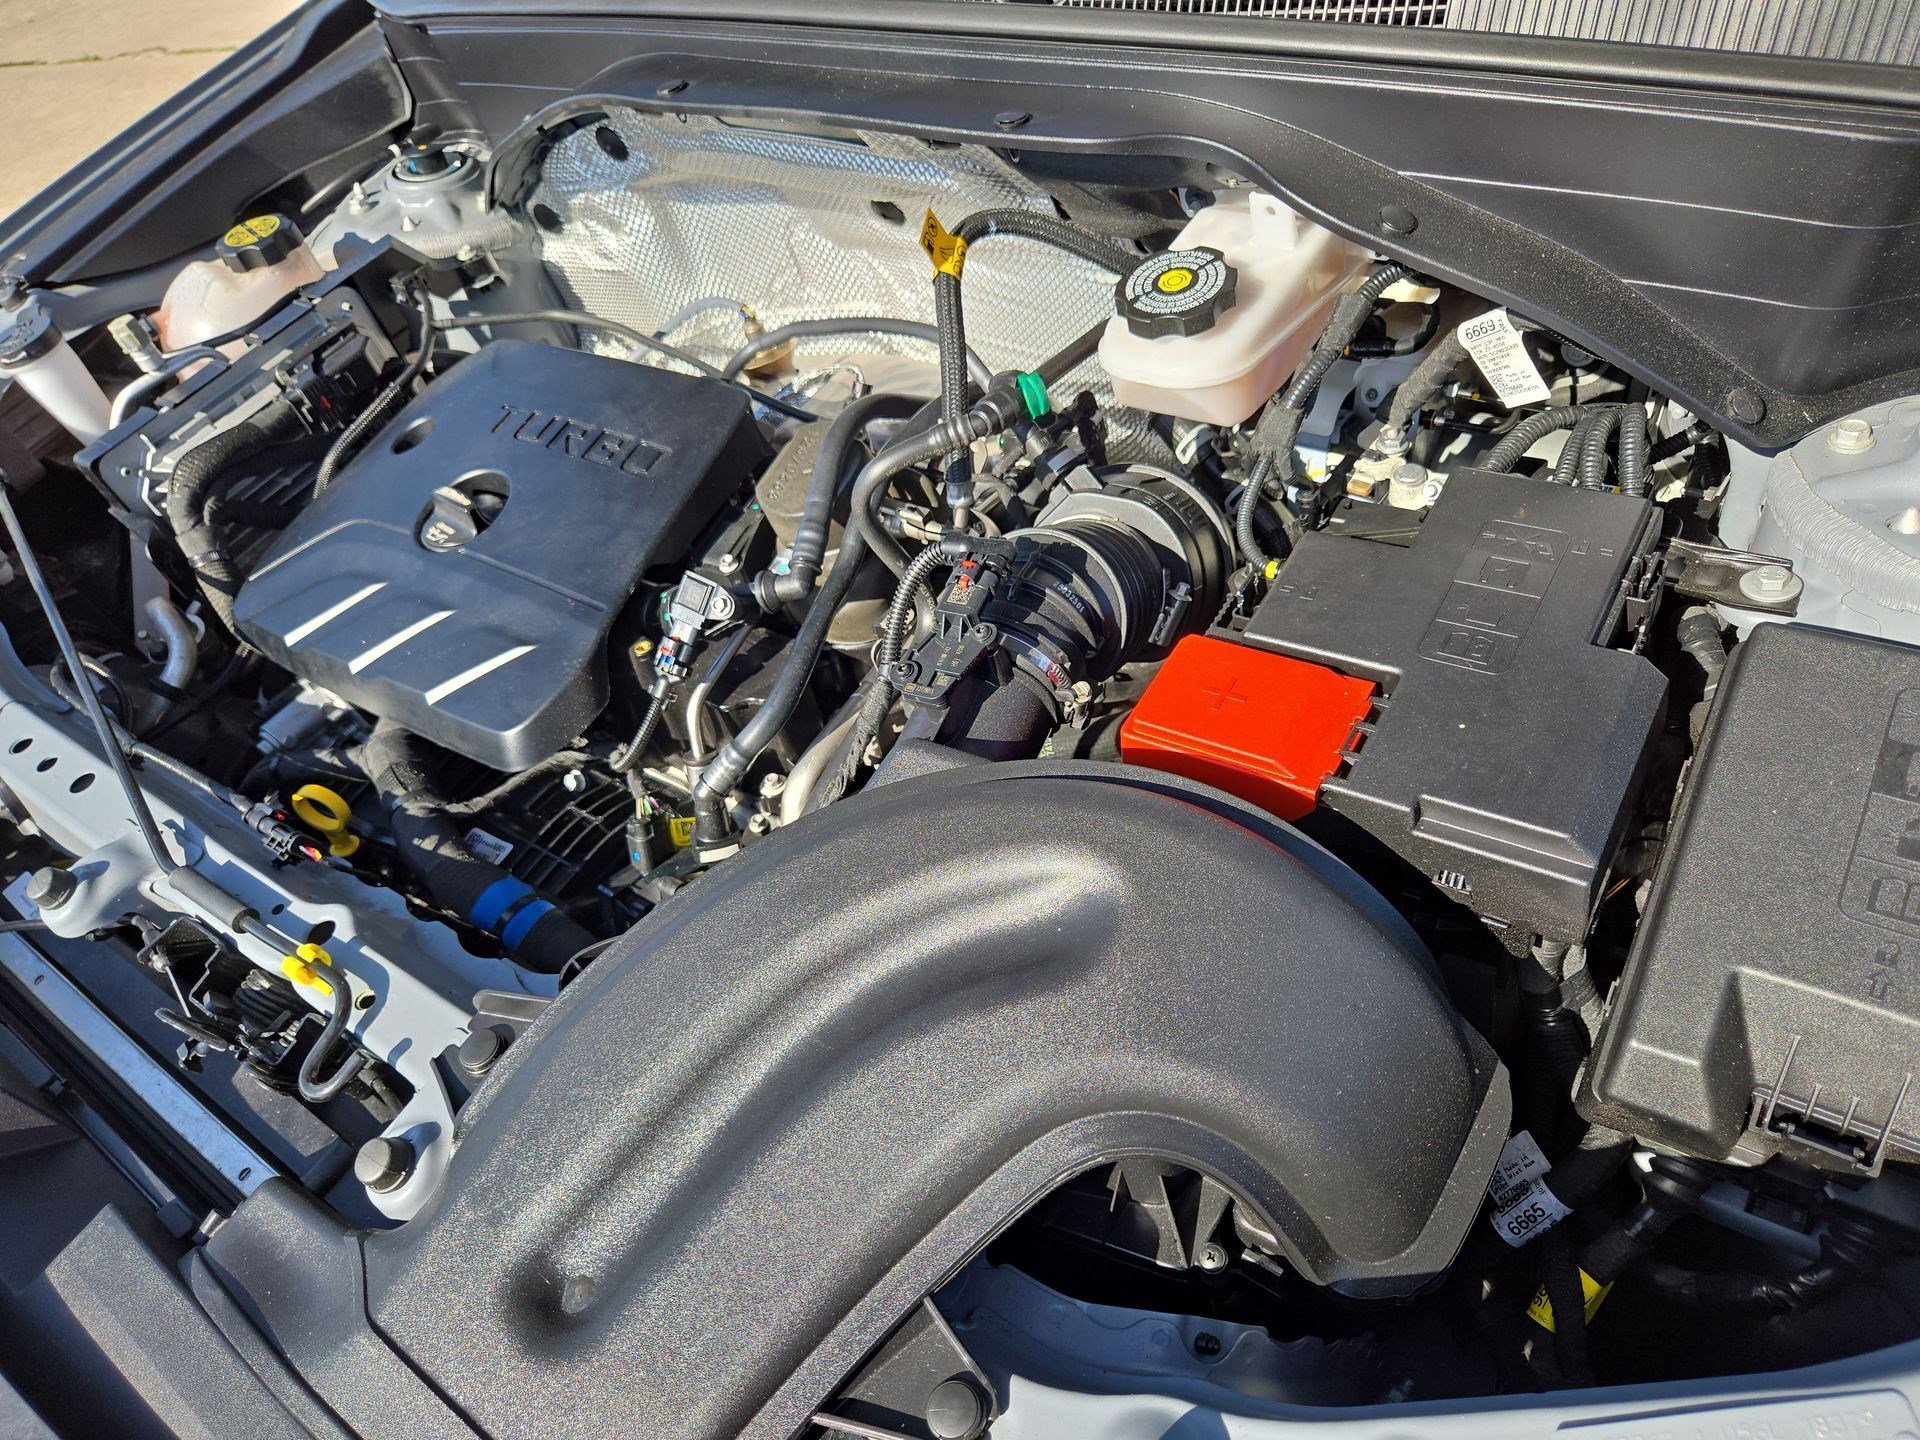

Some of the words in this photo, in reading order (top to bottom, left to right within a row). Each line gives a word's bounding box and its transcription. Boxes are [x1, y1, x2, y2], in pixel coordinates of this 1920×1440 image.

[1465, 319, 1496, 340] 6669
[491, 403, 673, 478] TURBO
[1504, 1161, 1519, 1174] Made
[1507, 1168, 1523, 1180] Viet
[1524, 1160, 1536, 1170] Nam
[1507, 1202, 1546, 1236] 6665
